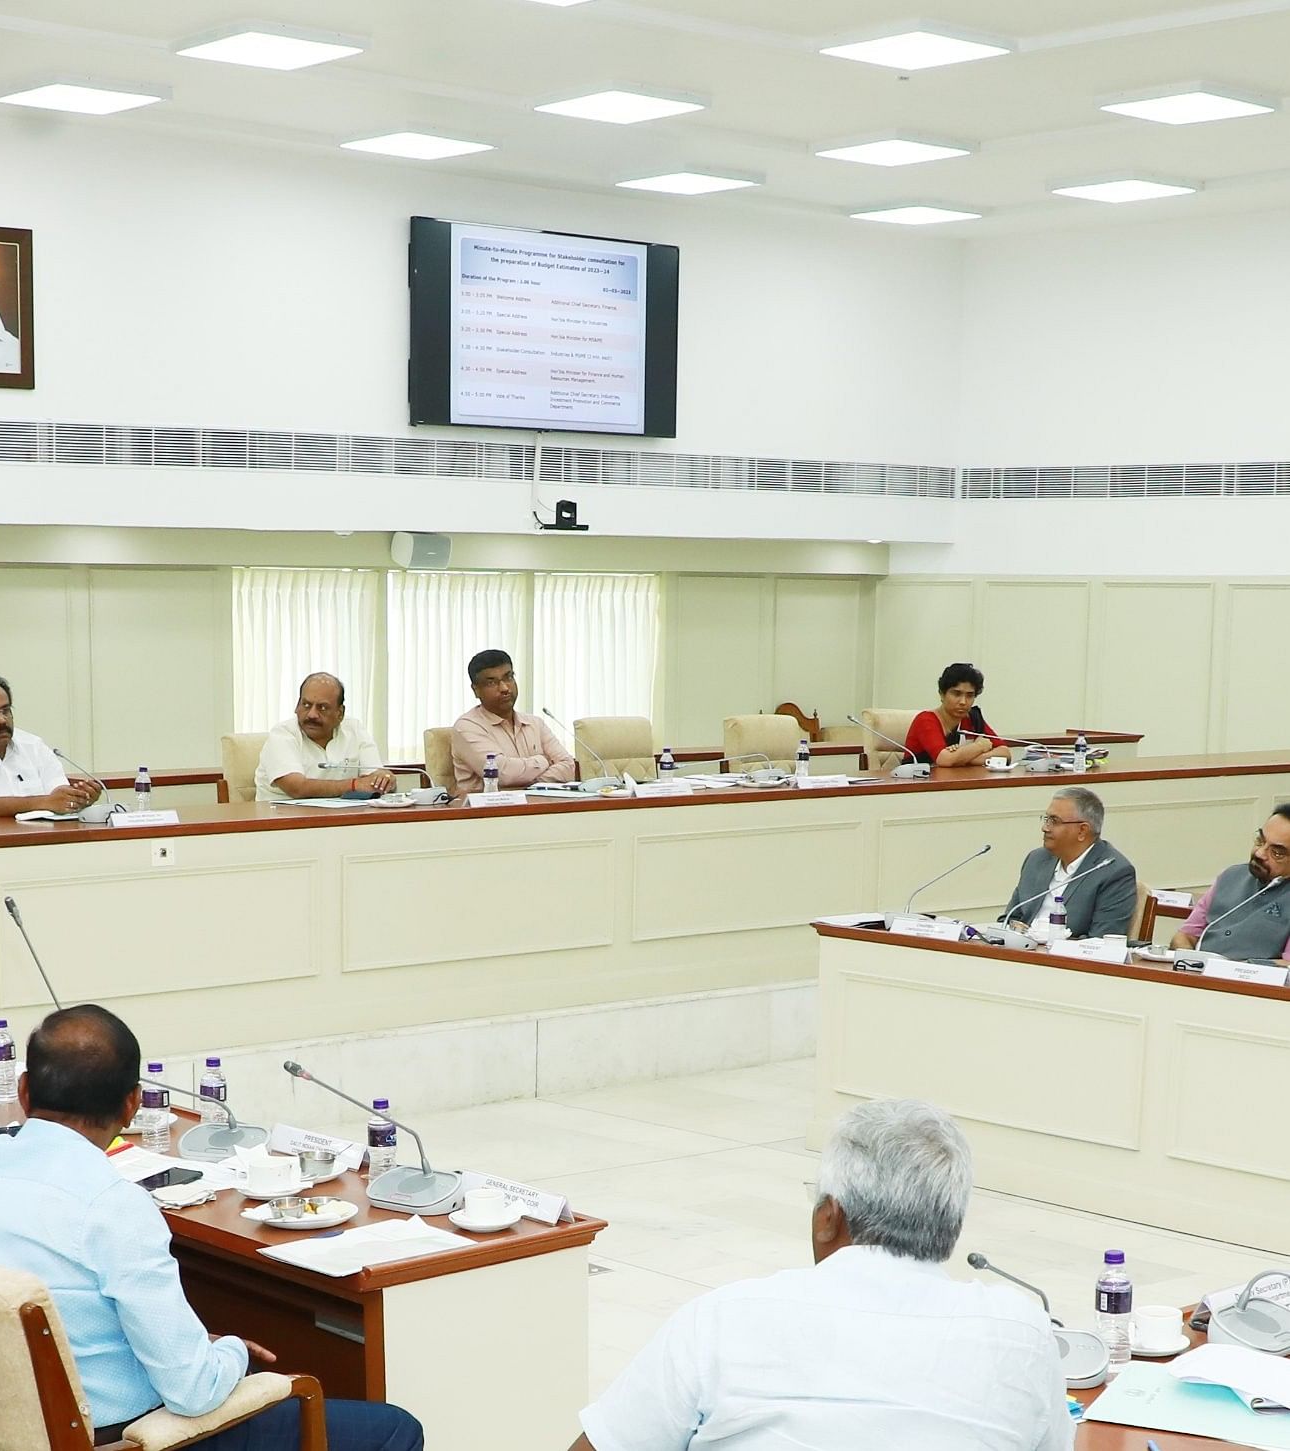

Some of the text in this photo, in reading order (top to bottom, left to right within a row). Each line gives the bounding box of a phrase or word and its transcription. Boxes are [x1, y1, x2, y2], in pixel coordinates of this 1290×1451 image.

[473, 244, 518, 254] Minute-to-Minute
[557, 254, 586, 262] Stakeholder
[500, 258, 529, 266] preparation
[556, 264, 580, 272] Estimates
[304, 1134, 333, 1147] PRESIDENT
[486, 1178, 509, 1191] GENERAL
[526, 1199, 540, 1208] COIR
